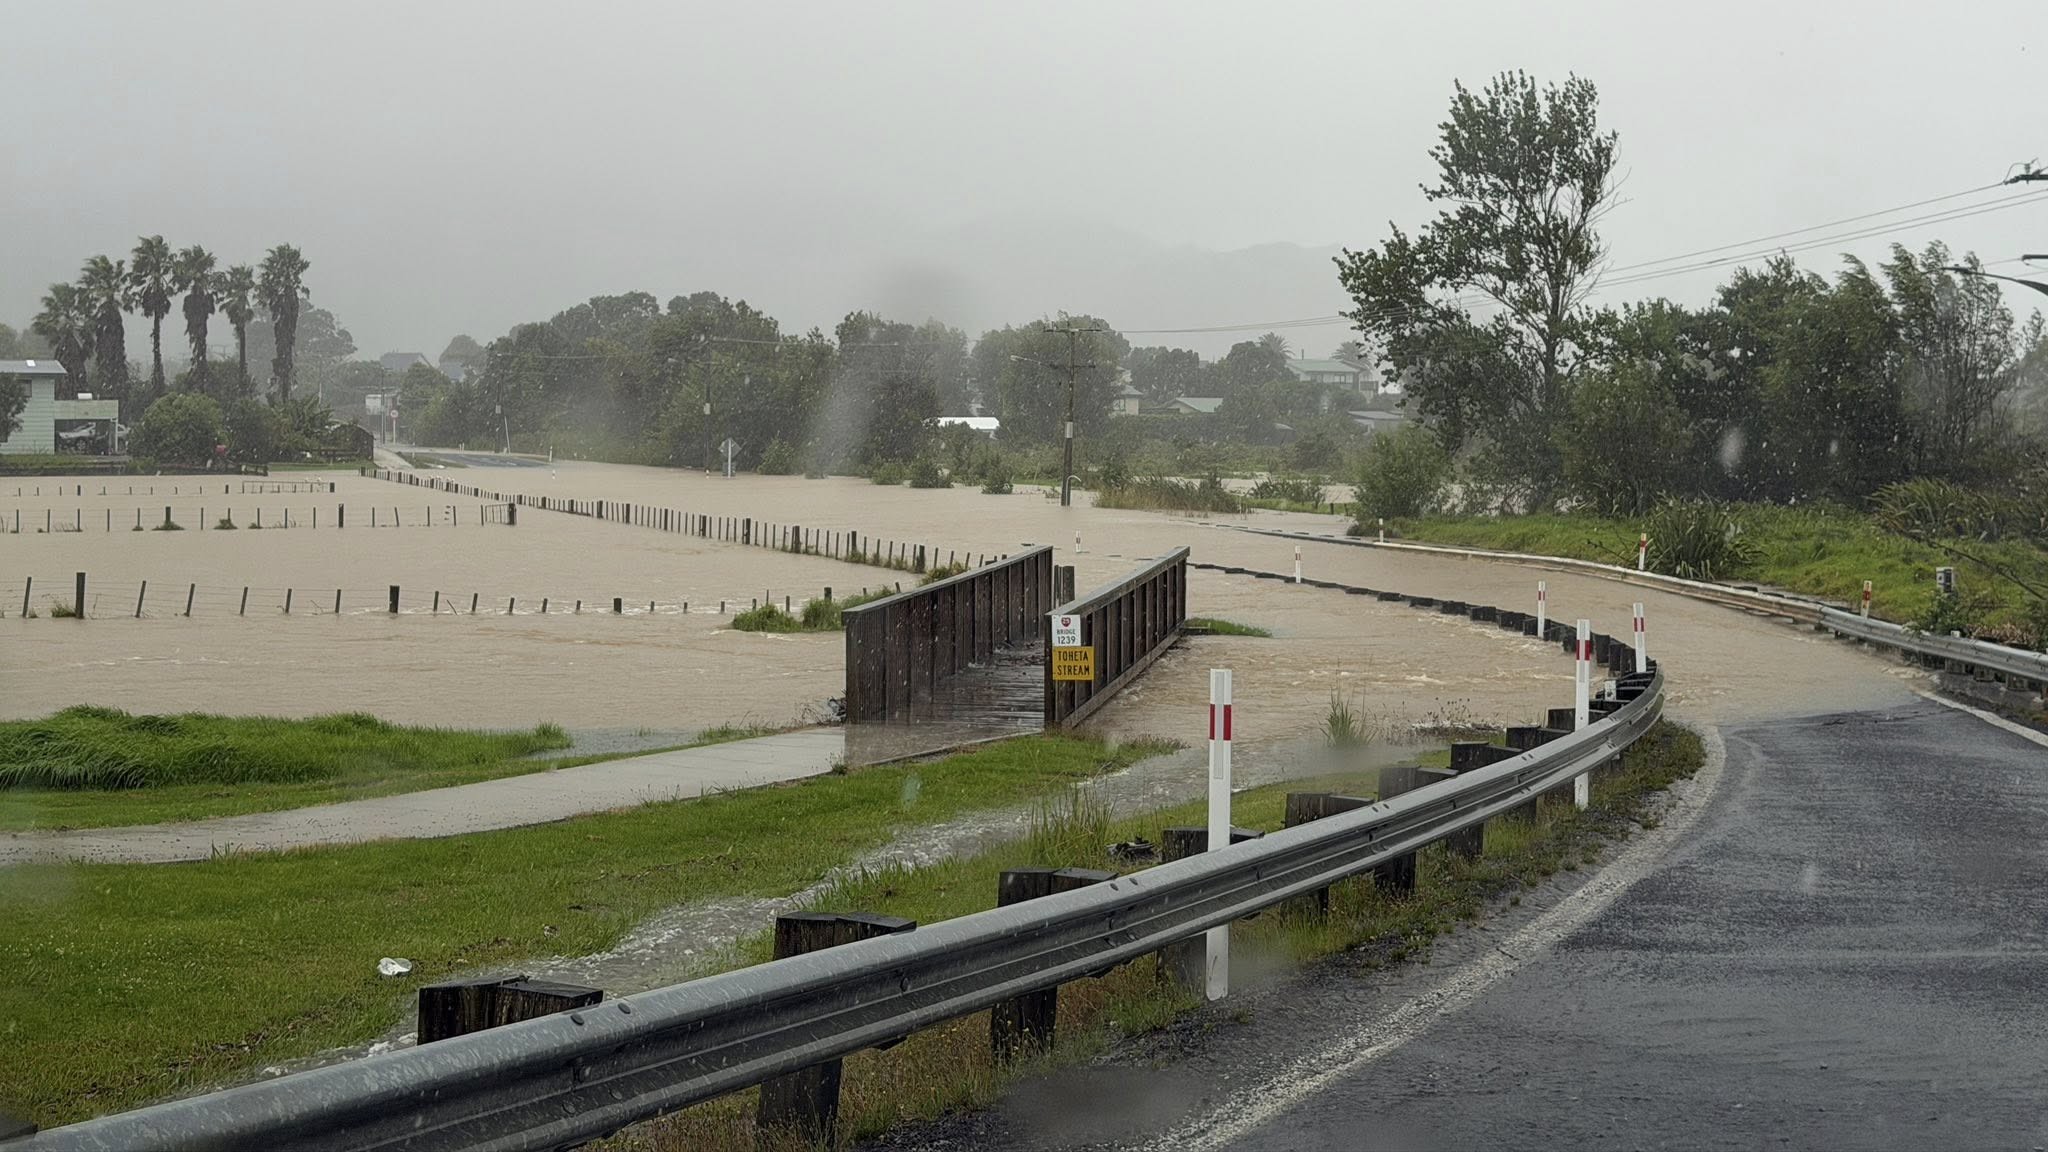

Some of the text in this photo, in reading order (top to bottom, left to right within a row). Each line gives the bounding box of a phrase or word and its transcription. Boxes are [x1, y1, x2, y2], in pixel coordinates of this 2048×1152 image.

[1057, 636, 1076, 645] 1239
[1058, 651, 1089, 661] TOHETA
[1057, 665, 1090, 676] STREAM
